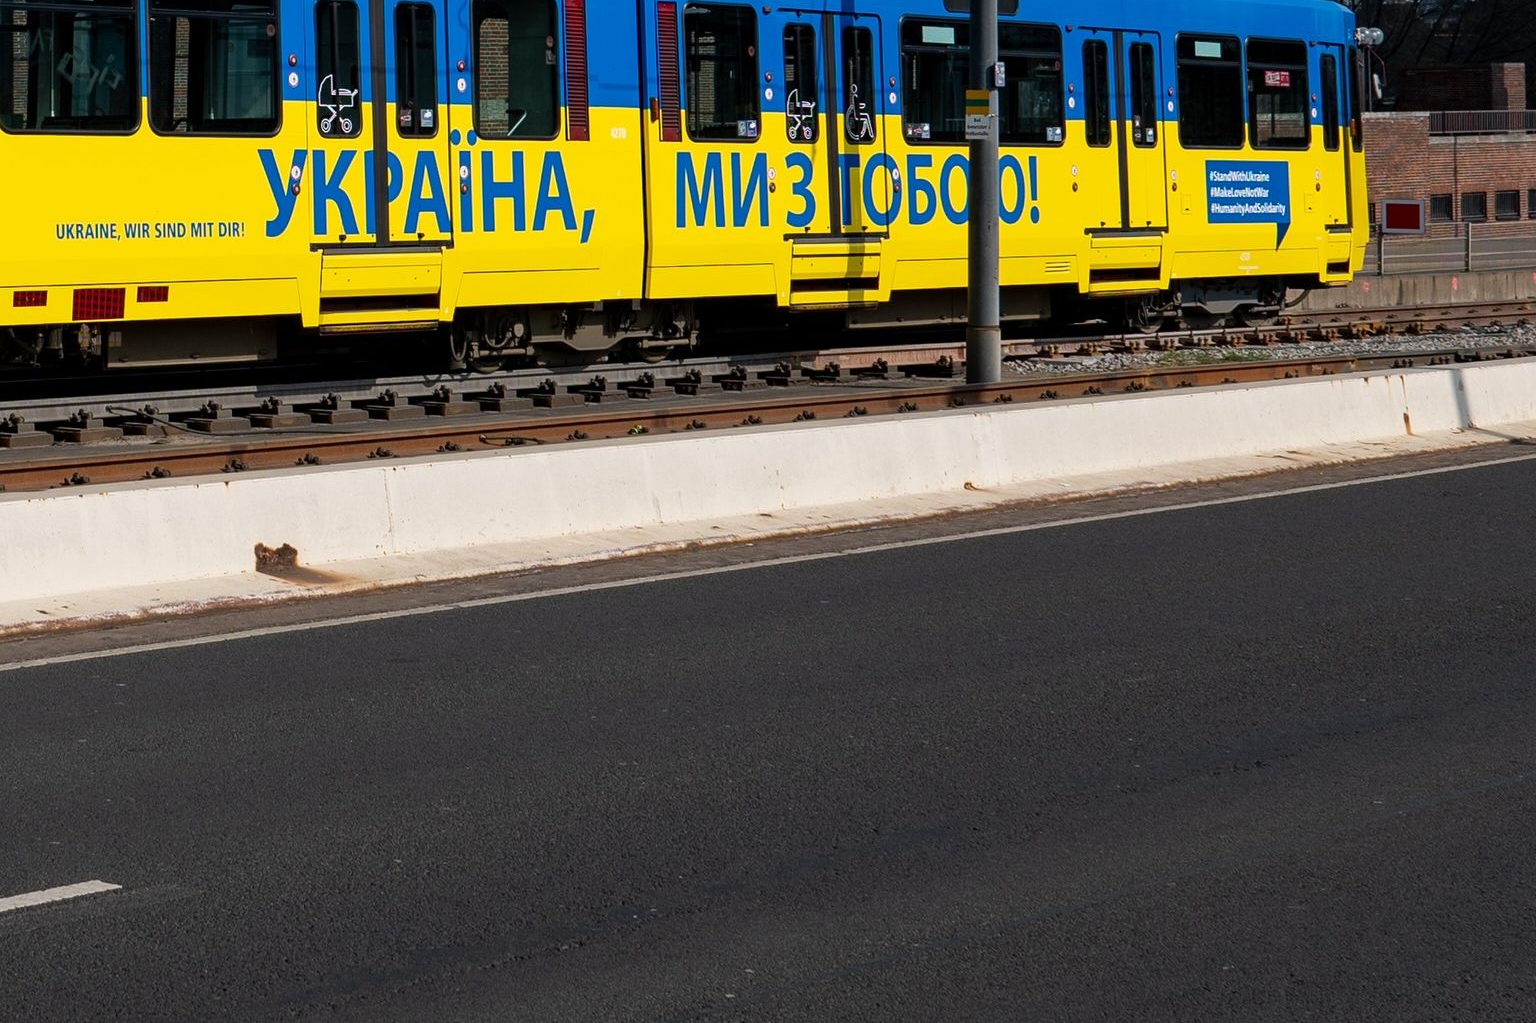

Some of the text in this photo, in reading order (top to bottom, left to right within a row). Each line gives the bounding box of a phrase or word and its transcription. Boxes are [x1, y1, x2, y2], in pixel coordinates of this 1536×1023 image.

[1209, 170, 1270, 182] #StandWithUkraine
[257, 129, 596, 244] УКРАЇНА,
[676, 151, 769, 228] МИ
[1210, 186, 1269, 198] #MakeLoveNotWar
[1211, 202, 1286, 216] #HumanityAndSolidarity
[56, 222, 245, 241] UKRAINE, WIR SIND MIT DIR!
